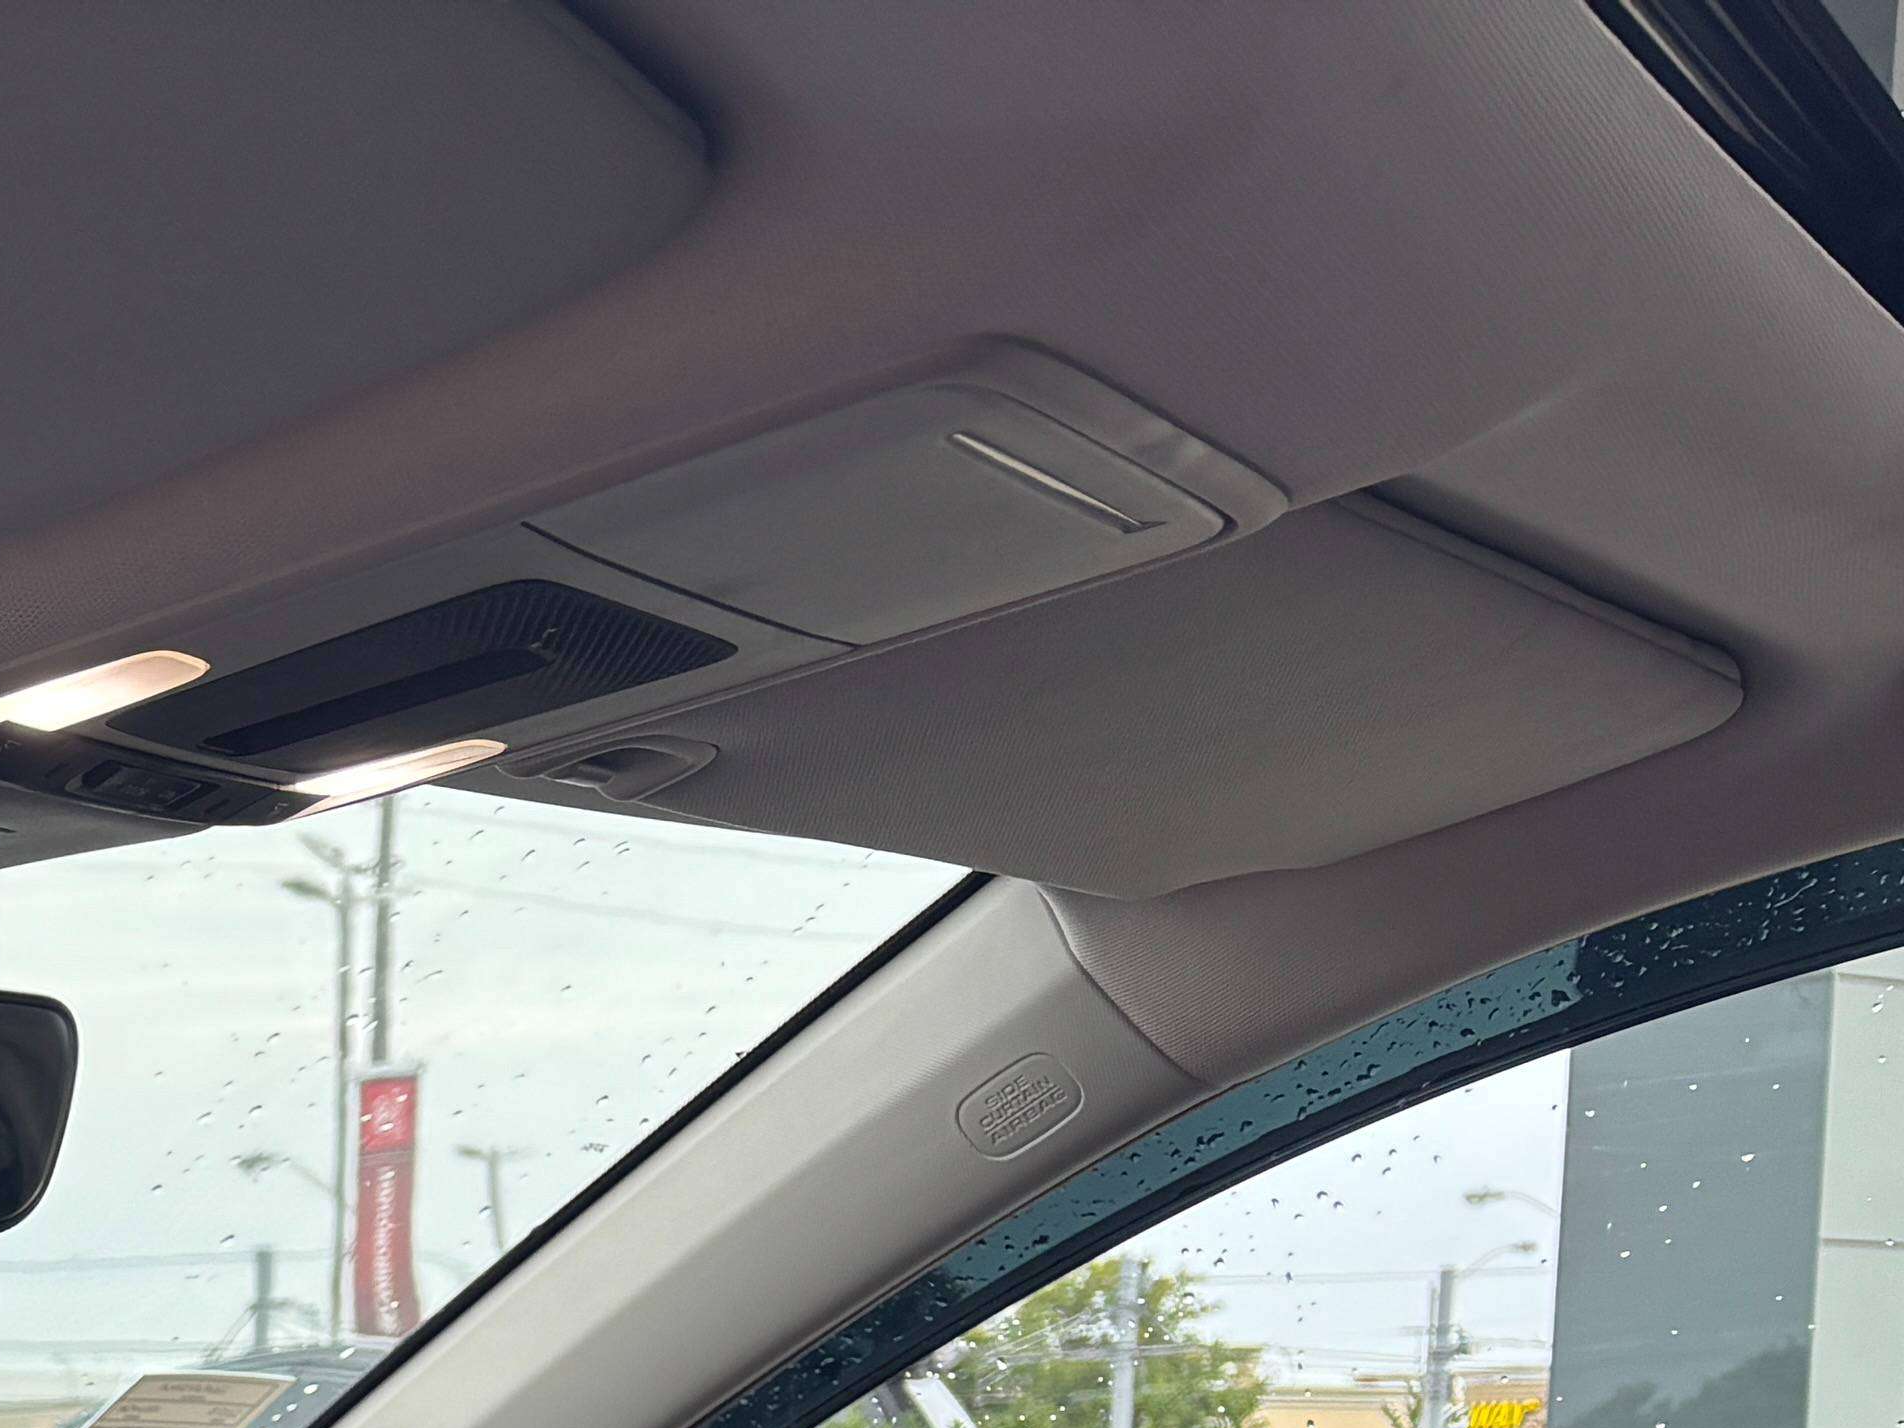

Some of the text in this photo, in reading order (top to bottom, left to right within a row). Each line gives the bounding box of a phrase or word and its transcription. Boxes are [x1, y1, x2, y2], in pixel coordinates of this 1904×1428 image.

[979, 1076, 1055, 1132] CURTAIN
[985, 1074, 1032, 1109] SIDE
[991, 1089, 1068, 1145] AIRBAG
